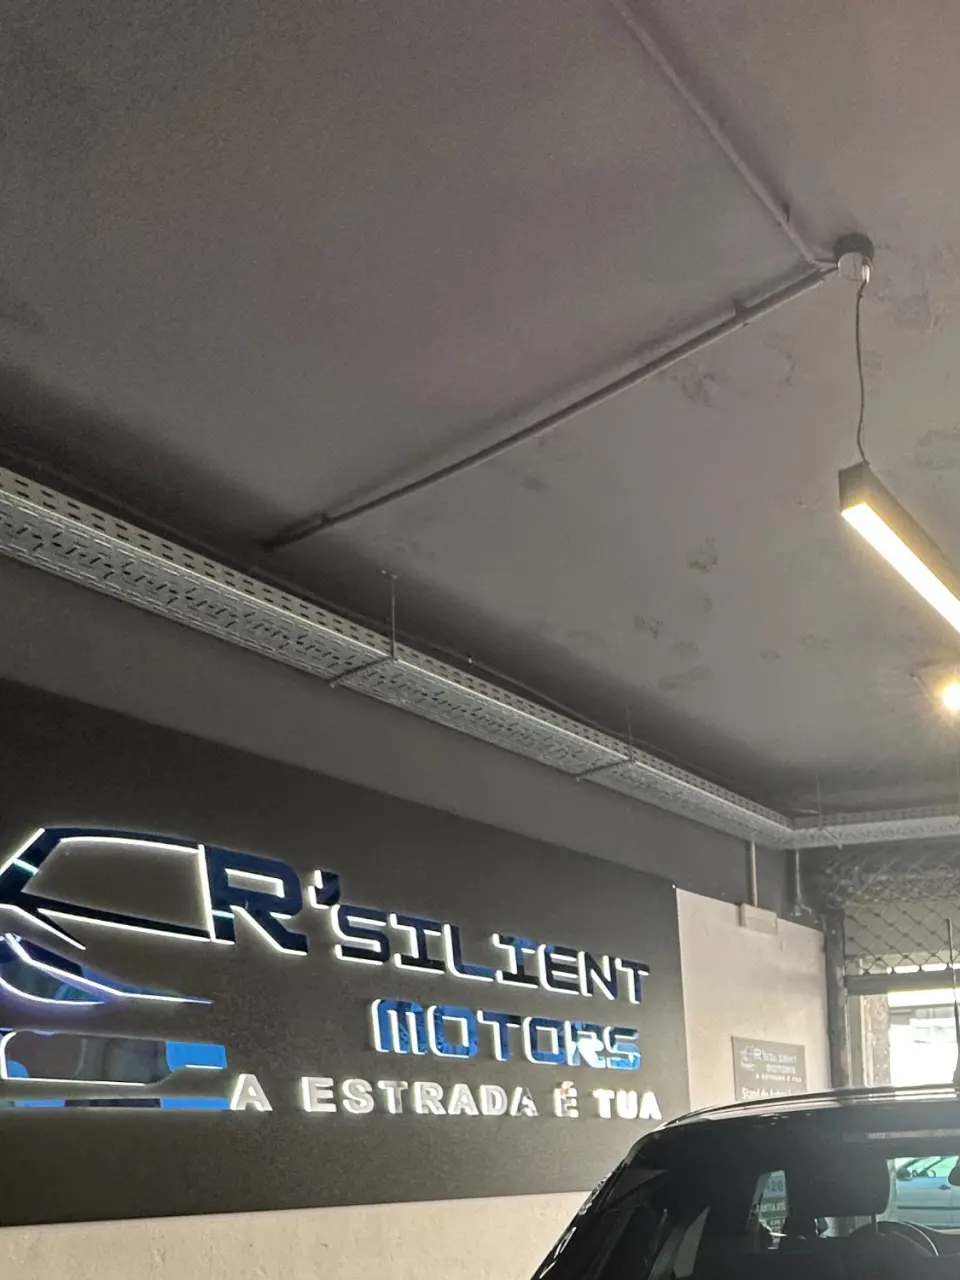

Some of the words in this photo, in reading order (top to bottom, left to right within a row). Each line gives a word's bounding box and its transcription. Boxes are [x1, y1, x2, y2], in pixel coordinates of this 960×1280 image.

[199, 843, 650, 1004] R'SILIENT
[371, 998, 641, 1070] MOTORS
[230, 1073, 273, 1112] A
[301, 1076, 539, 1118] ESTRADA
[554, 1080, 579, 1119] É
[597, 1087, 663, 1120] TUA
